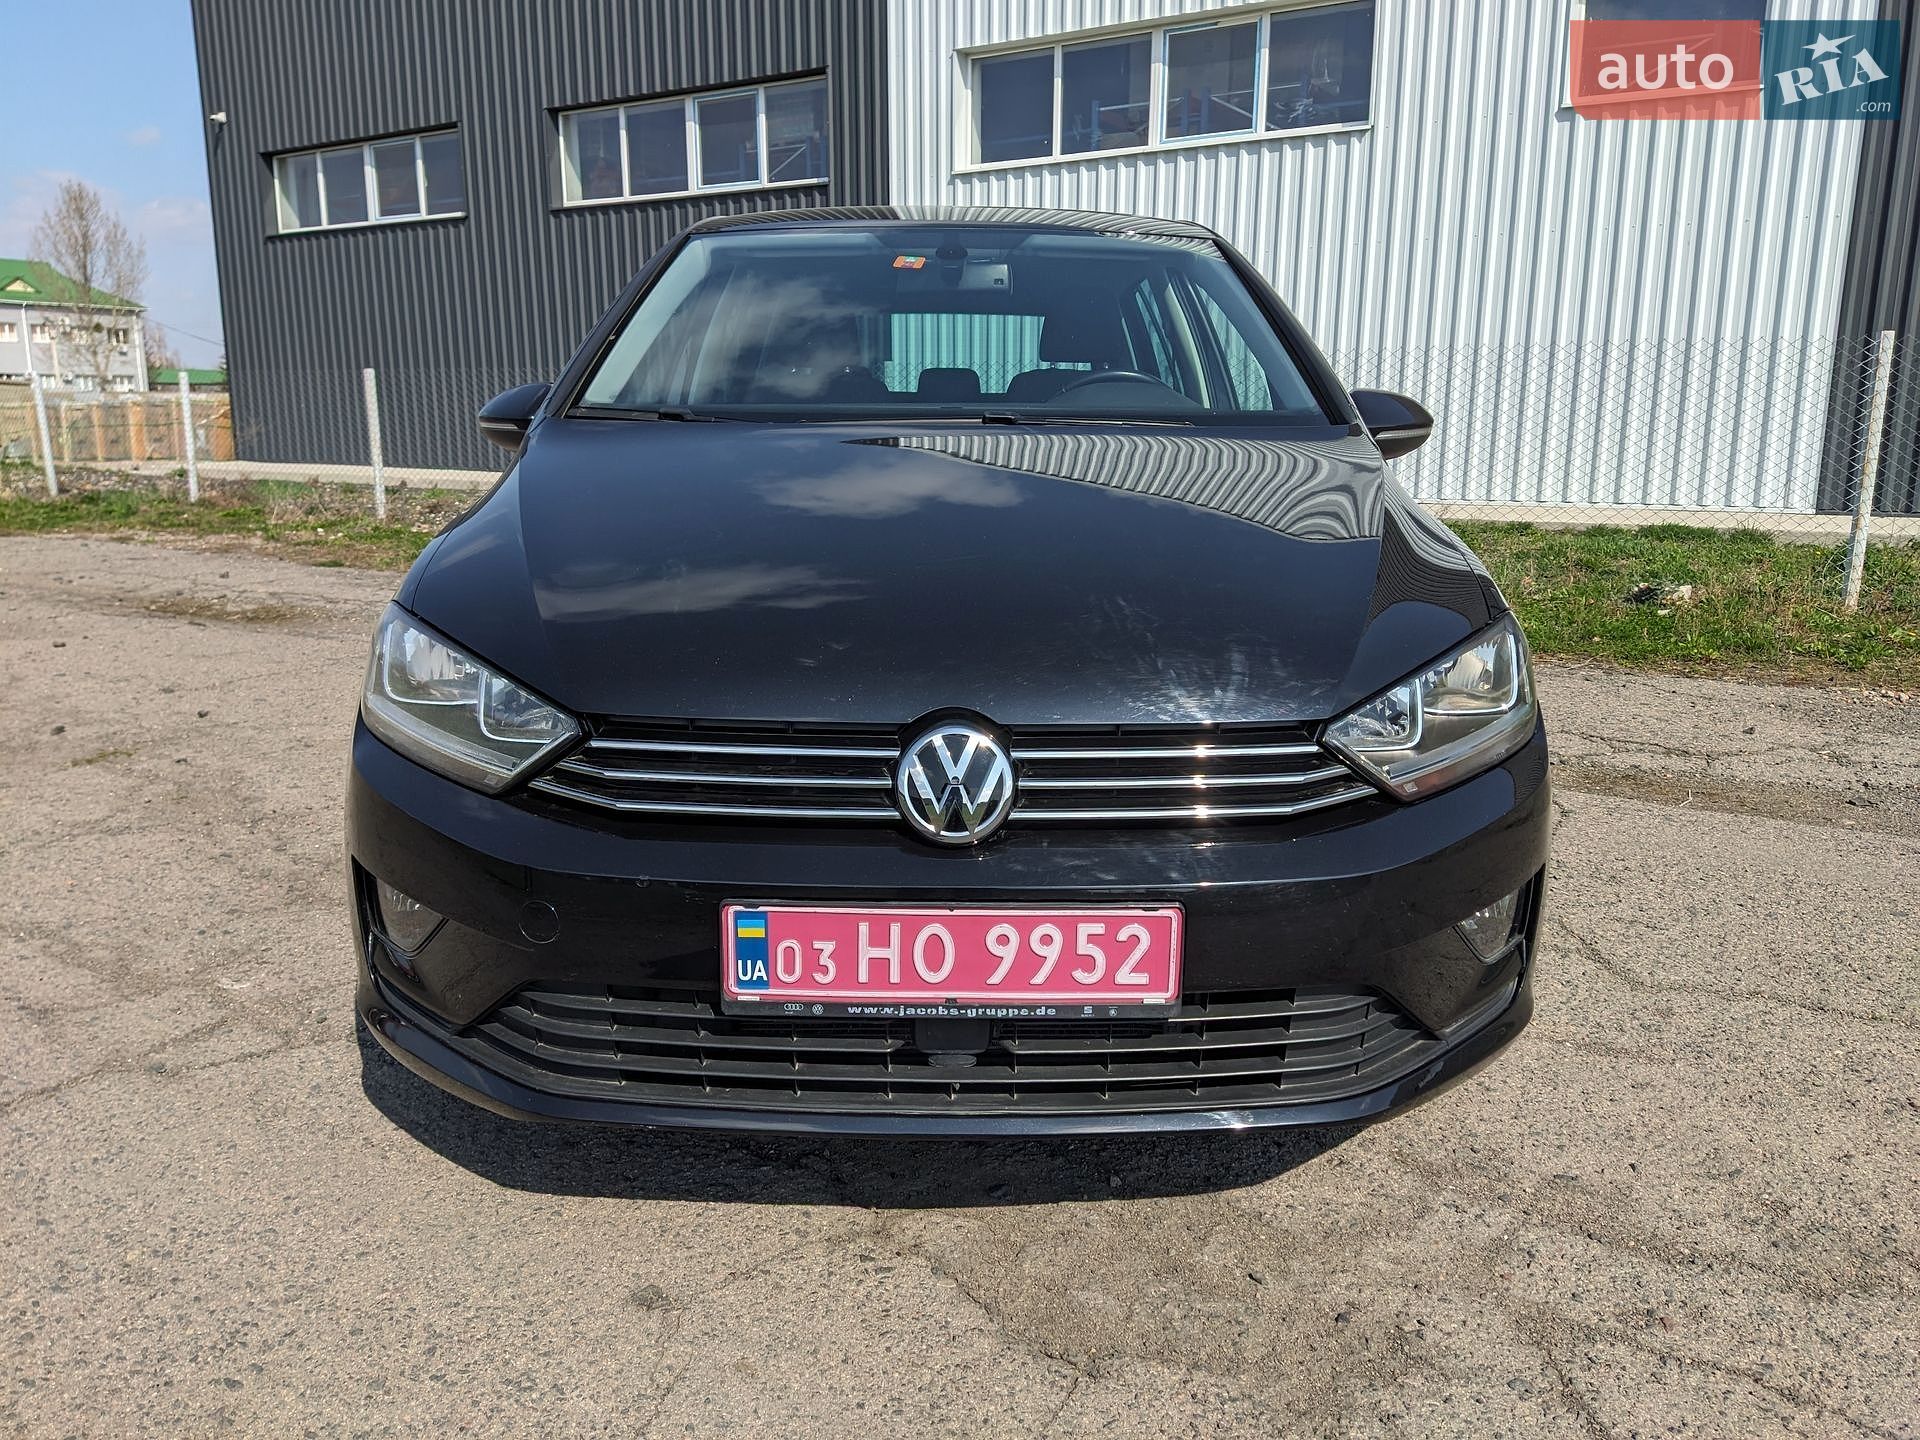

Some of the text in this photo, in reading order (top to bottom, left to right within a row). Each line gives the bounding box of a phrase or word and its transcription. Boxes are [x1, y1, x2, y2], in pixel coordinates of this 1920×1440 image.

[776, 922, 1151, 985] 03 HO 9952
[737, 959, 768, 981] UA
[847, 1005, 1057, 1017] www.jacobs-gruppe.de
